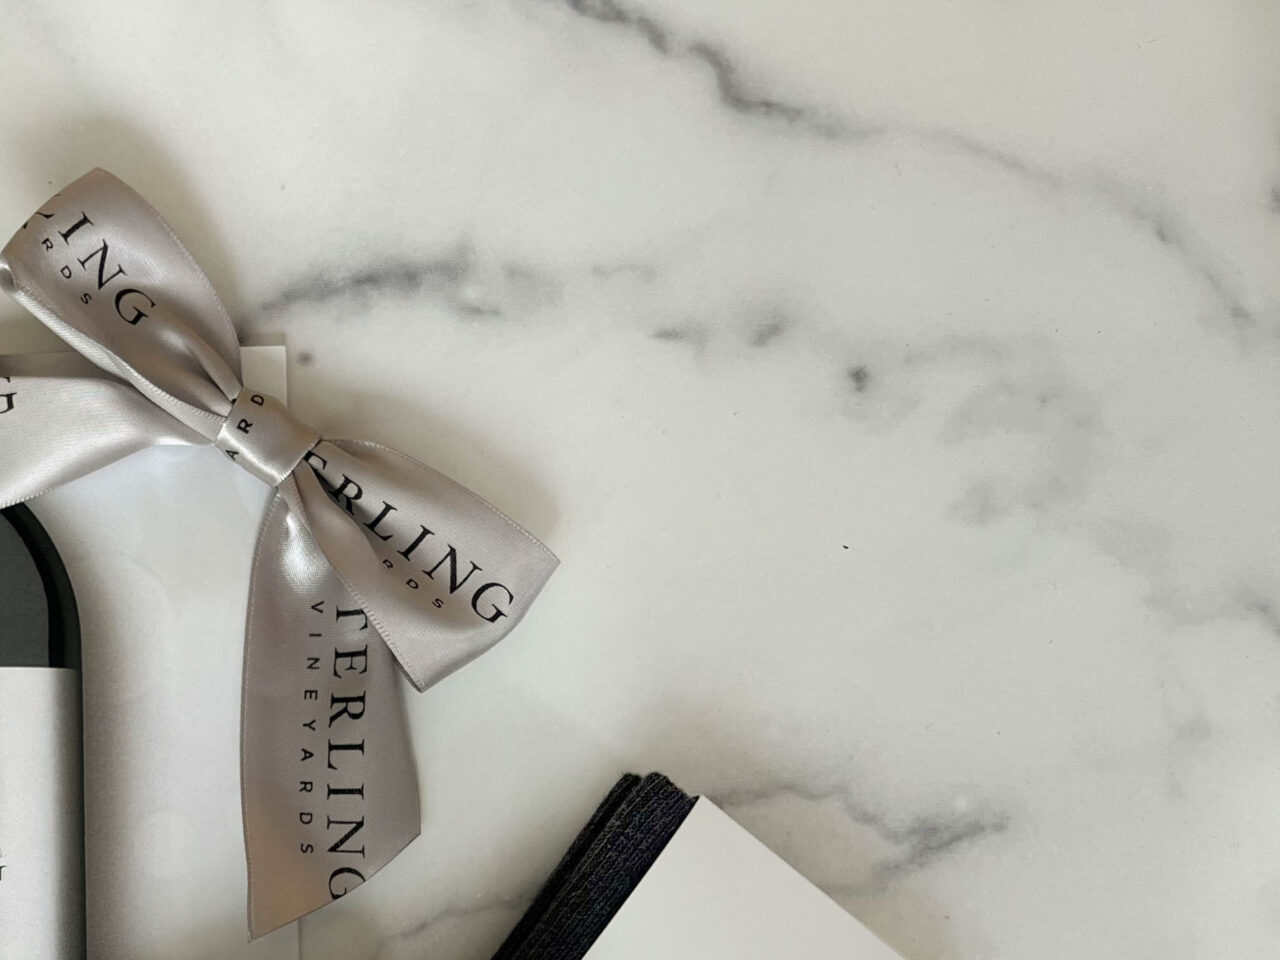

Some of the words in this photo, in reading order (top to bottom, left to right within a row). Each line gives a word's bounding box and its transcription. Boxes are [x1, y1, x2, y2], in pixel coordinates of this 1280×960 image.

[22, 221, 92, 305] RDS
[35, 193, 156, 326] ING
[299, 600, 325, 855] VINEYARDS
